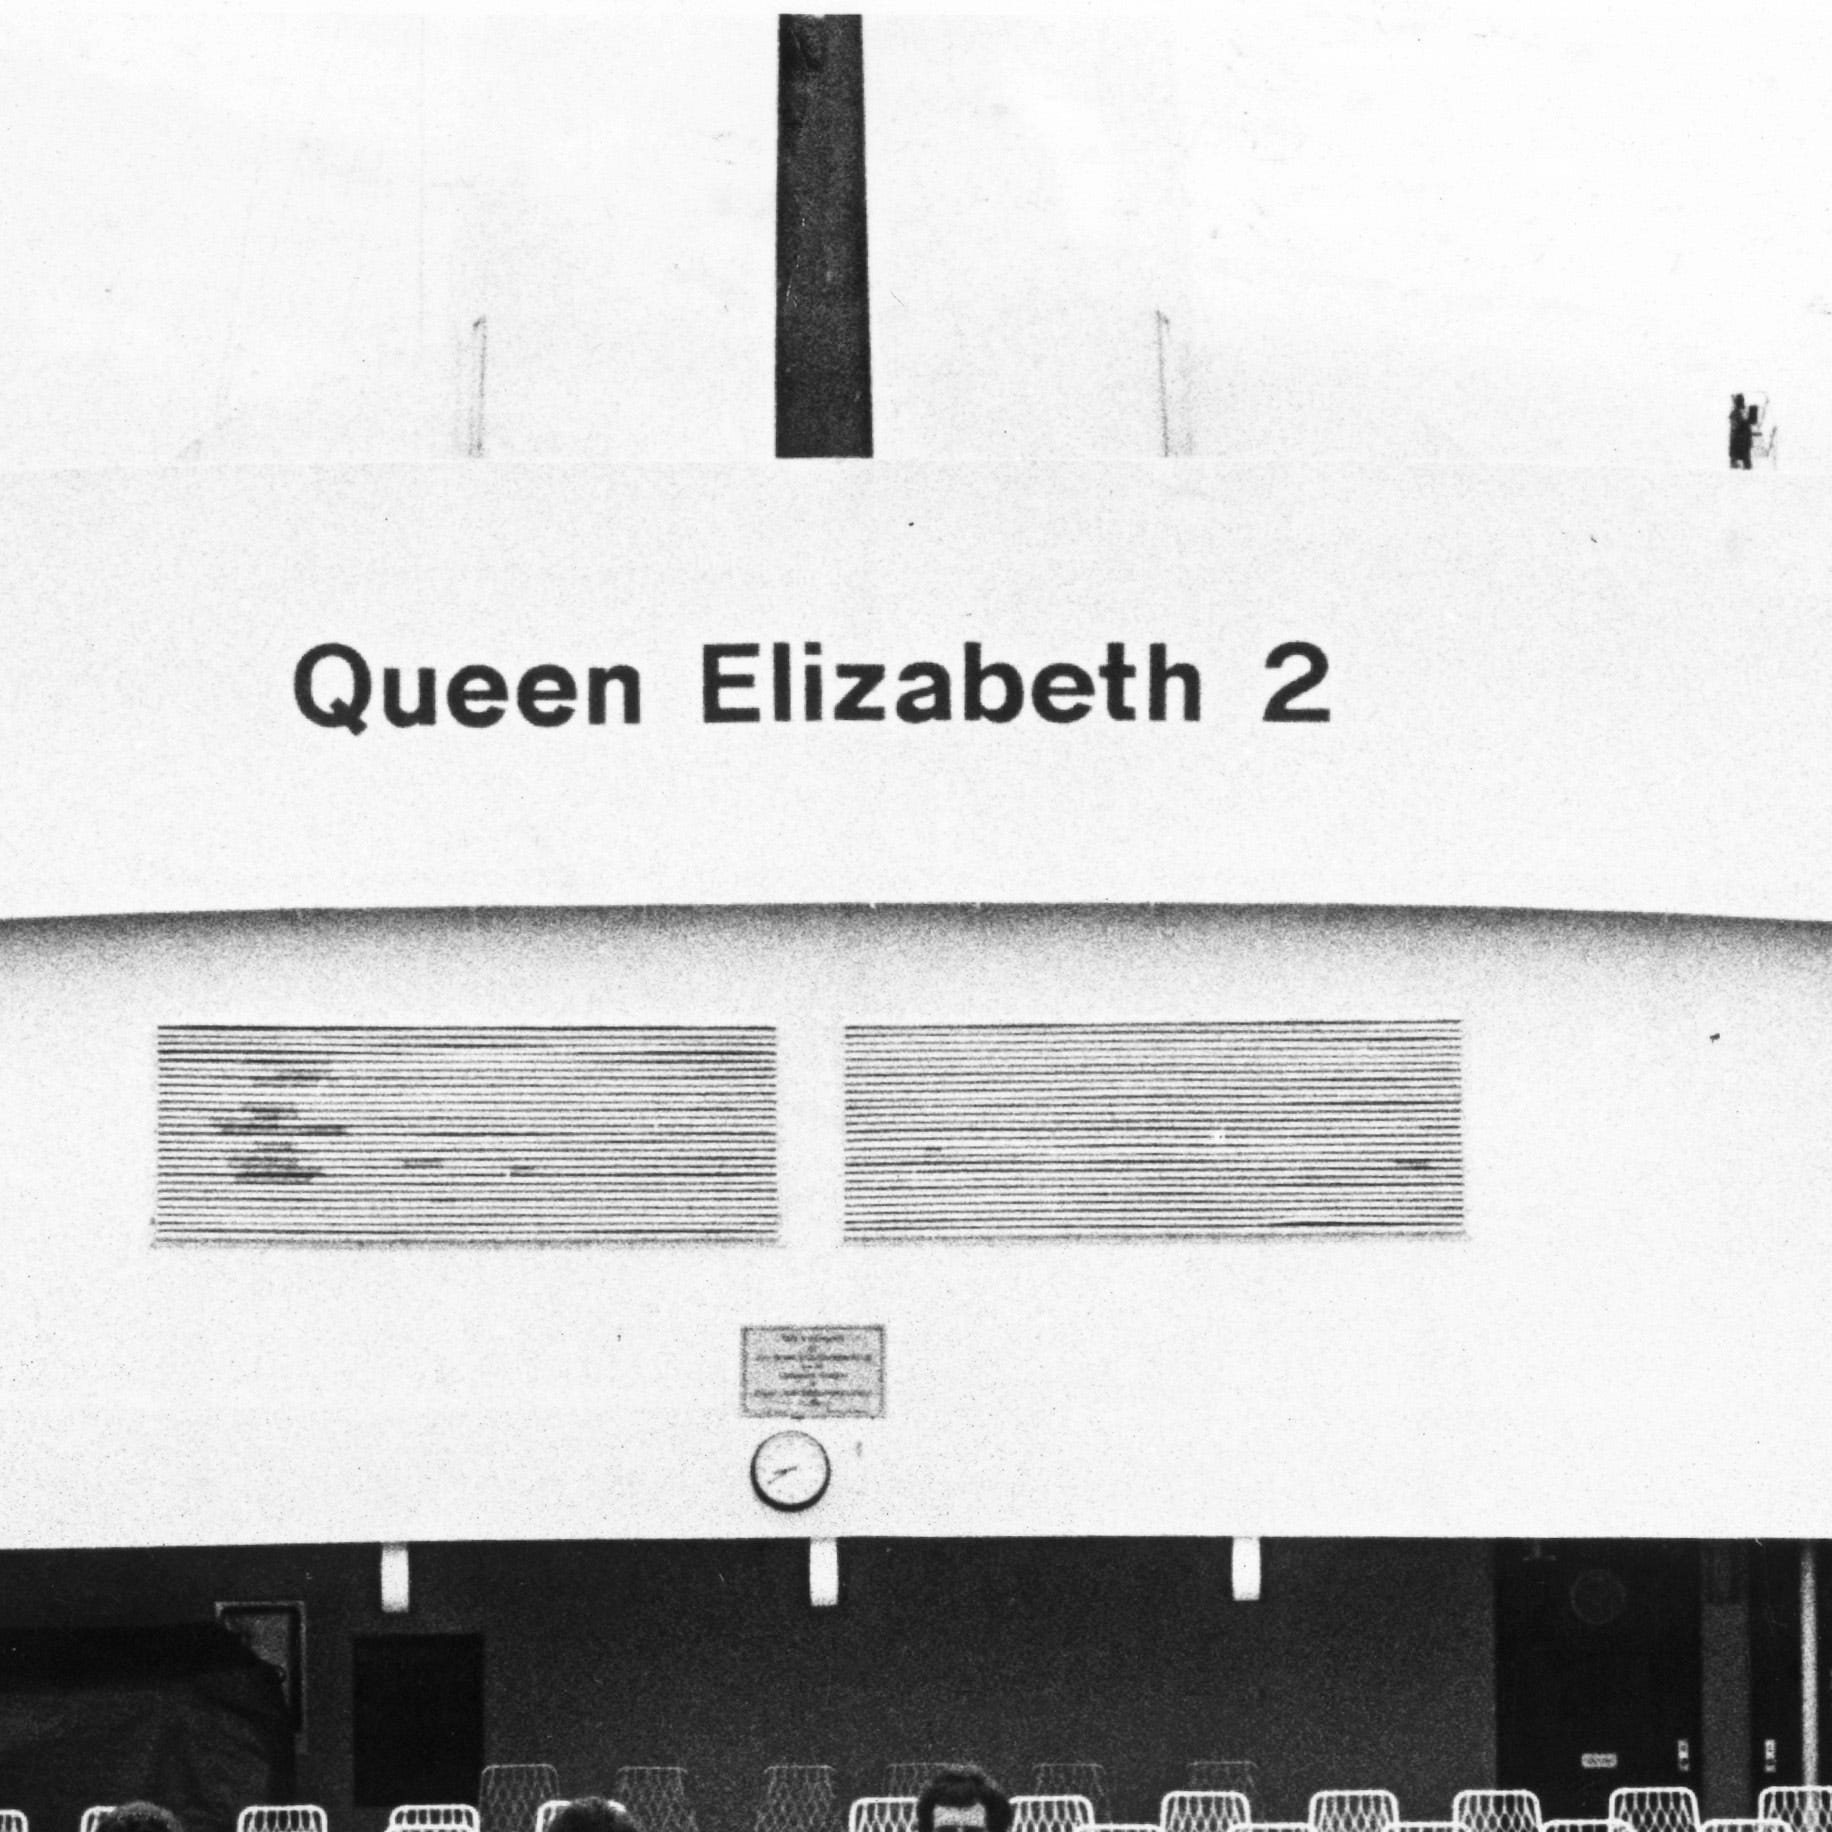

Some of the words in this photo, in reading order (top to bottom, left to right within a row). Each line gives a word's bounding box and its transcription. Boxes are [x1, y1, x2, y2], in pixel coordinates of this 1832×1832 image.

[293, 642, 641, 736] Queen
[702, 641, 1201, 725] Elizabeth
[1262, 641, 1331, 723] 2
